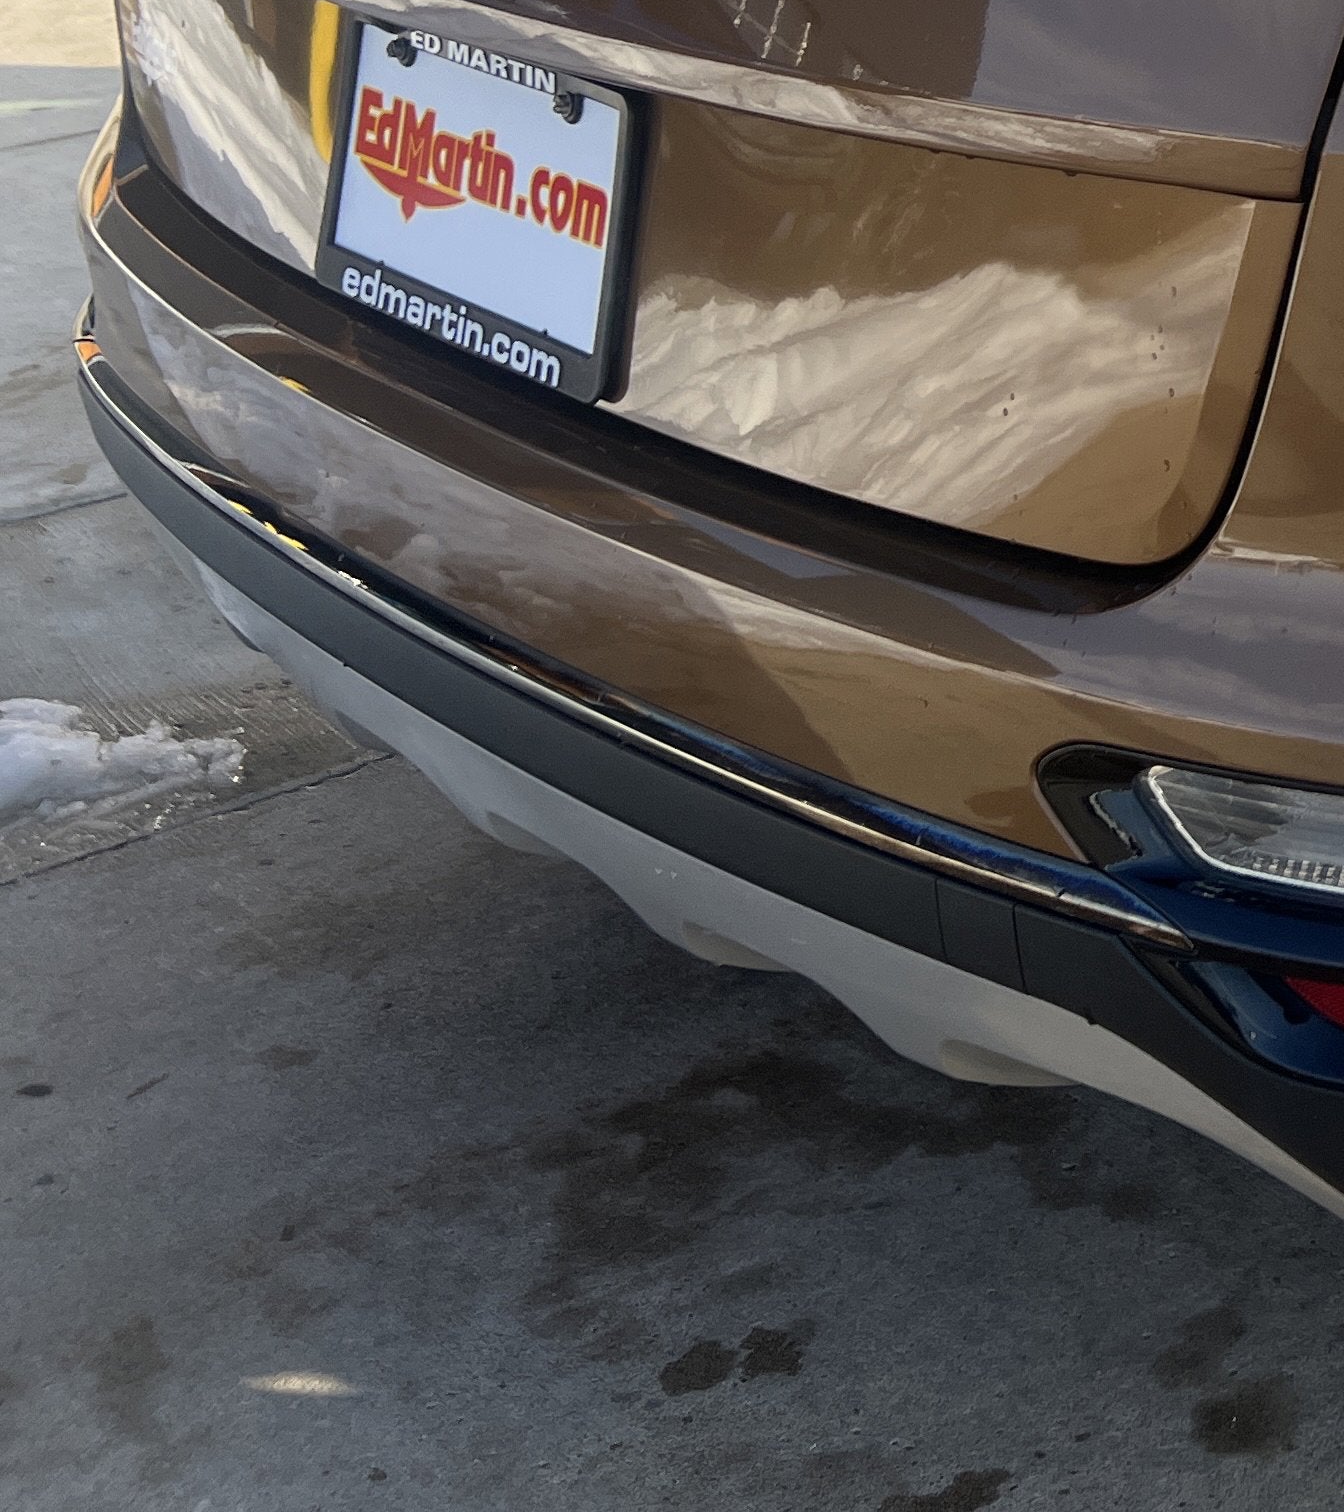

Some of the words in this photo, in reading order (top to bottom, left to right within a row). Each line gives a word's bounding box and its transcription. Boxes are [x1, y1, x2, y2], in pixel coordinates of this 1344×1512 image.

[410, 29, 442, 55] ED
[447, 39, 556, 95] MARTIN
[353, 85, 609, 249] EdMartin.com
[341, 265, 561, 389] edmartin.com
